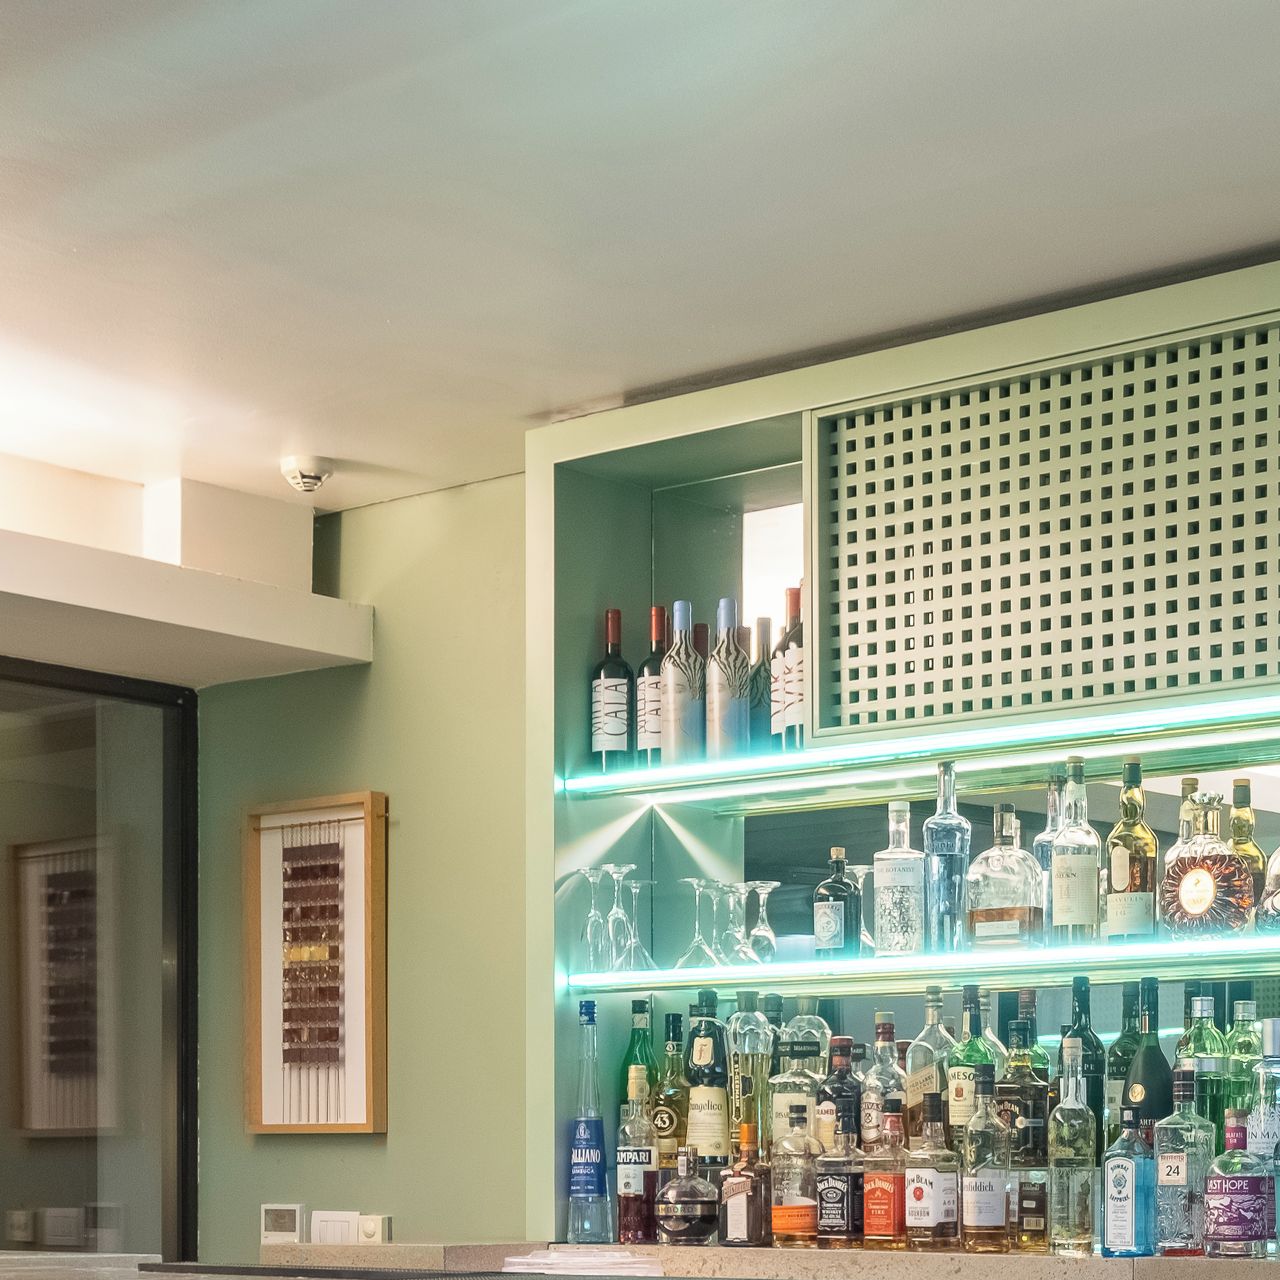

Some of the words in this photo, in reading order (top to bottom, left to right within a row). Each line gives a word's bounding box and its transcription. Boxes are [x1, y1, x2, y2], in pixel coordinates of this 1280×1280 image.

[654, 1114, 670, 1127] 43
[572, 1148, 600, 1165] ALLIANO
[1166, 1165, 1180, 1176] 24
[916, 1174, 934, 1189] BEAM
[1208, 1180, 1222, 1192] LAST
[1222, 1180, 1248, 1192] HOPE
